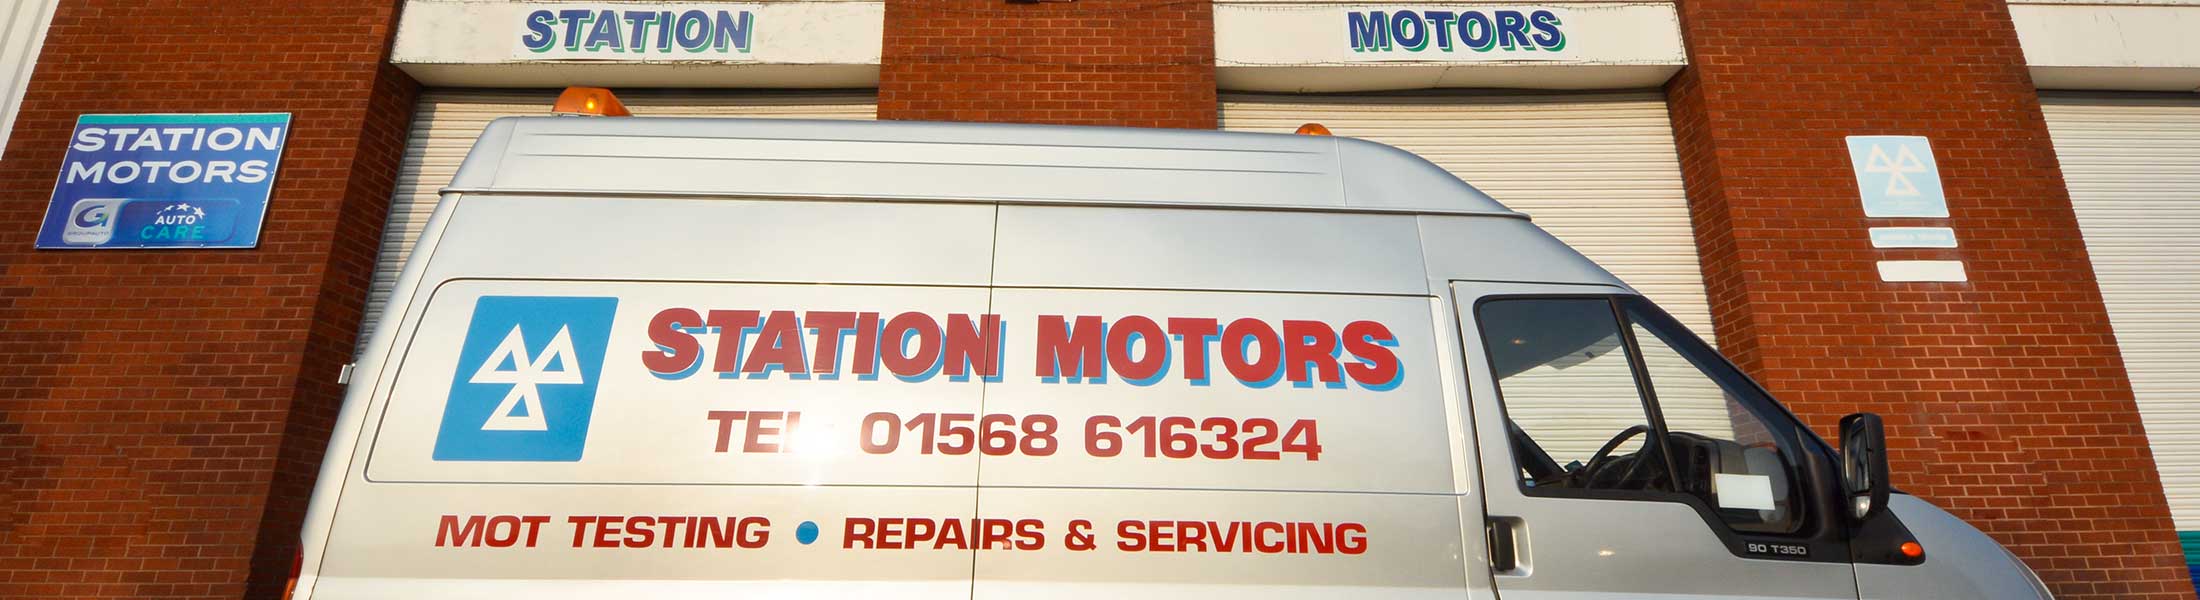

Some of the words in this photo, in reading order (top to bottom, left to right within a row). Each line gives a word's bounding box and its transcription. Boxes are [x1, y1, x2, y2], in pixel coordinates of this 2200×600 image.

[522, 9, 754, 53] STATION
[1347, 10, 1566, 52] MOTORS
[73, 127, 281, 151] STATION
[66, 160, 268, 184] MOTORS
[141, 225, 205, 240] CARE
[155, 215, 196, 225] AUTO
[642, 307, 1007, 383] STATION
[1036, 314, 1405, 392] MOTORS
[860, 411, 1058, 456] 01568
[1084, 415, 1322, 461] 616324
[435, 515, 551, 548] MOT
[567, 515, 771, 549] TESTING
[843, 517, 1045, 550] REPAIRS
[1064, 519, 1096, 551] &
[1117, 519, 1367, 555] SERVICING
[1748, 543, 1767, 552] 90
[1770, 544, 1807, 554] T350
